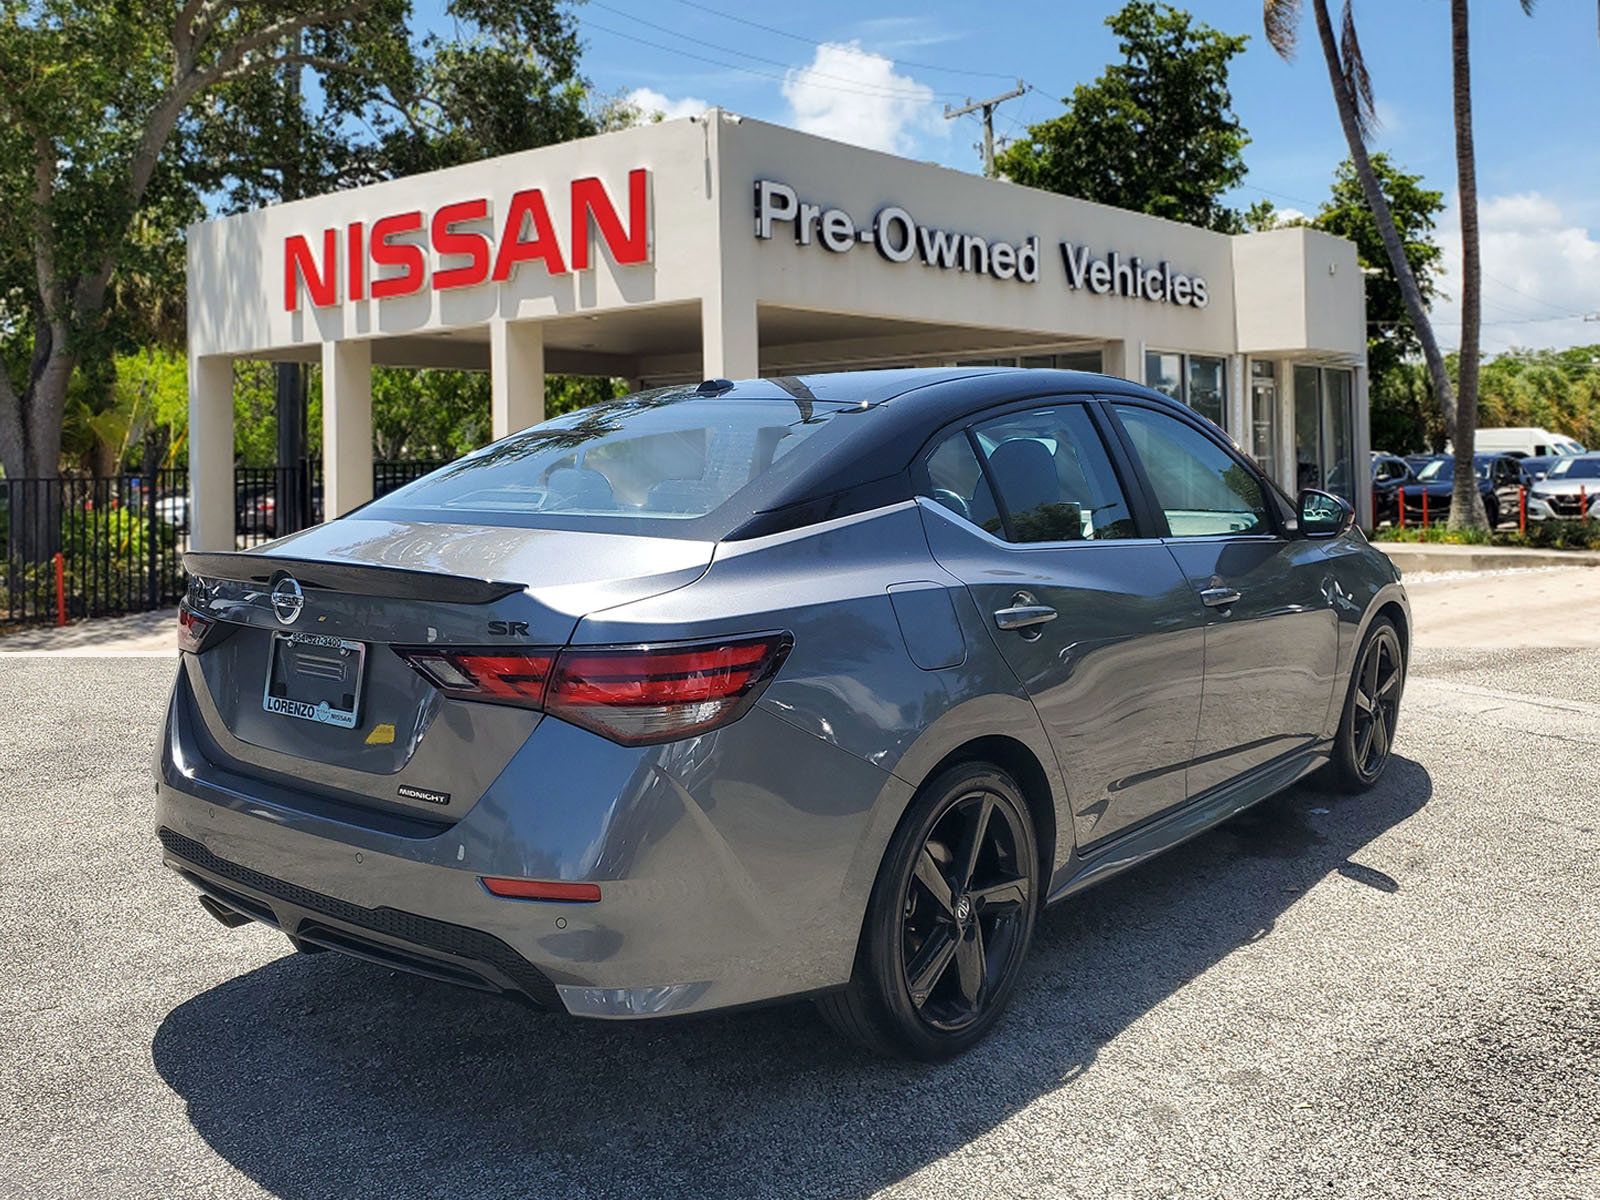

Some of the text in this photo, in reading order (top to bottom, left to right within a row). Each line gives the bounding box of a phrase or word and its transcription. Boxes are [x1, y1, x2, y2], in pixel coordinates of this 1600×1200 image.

[285, 167, 648, 312] NISSAN
[754, 180, 1209, 308] Pre-Owned Vehicles
[487, 620, 530, 637] SR
[267, 698, 315, 718] LORENZO
[398, 788, 446, 803] MIDNIGHT
